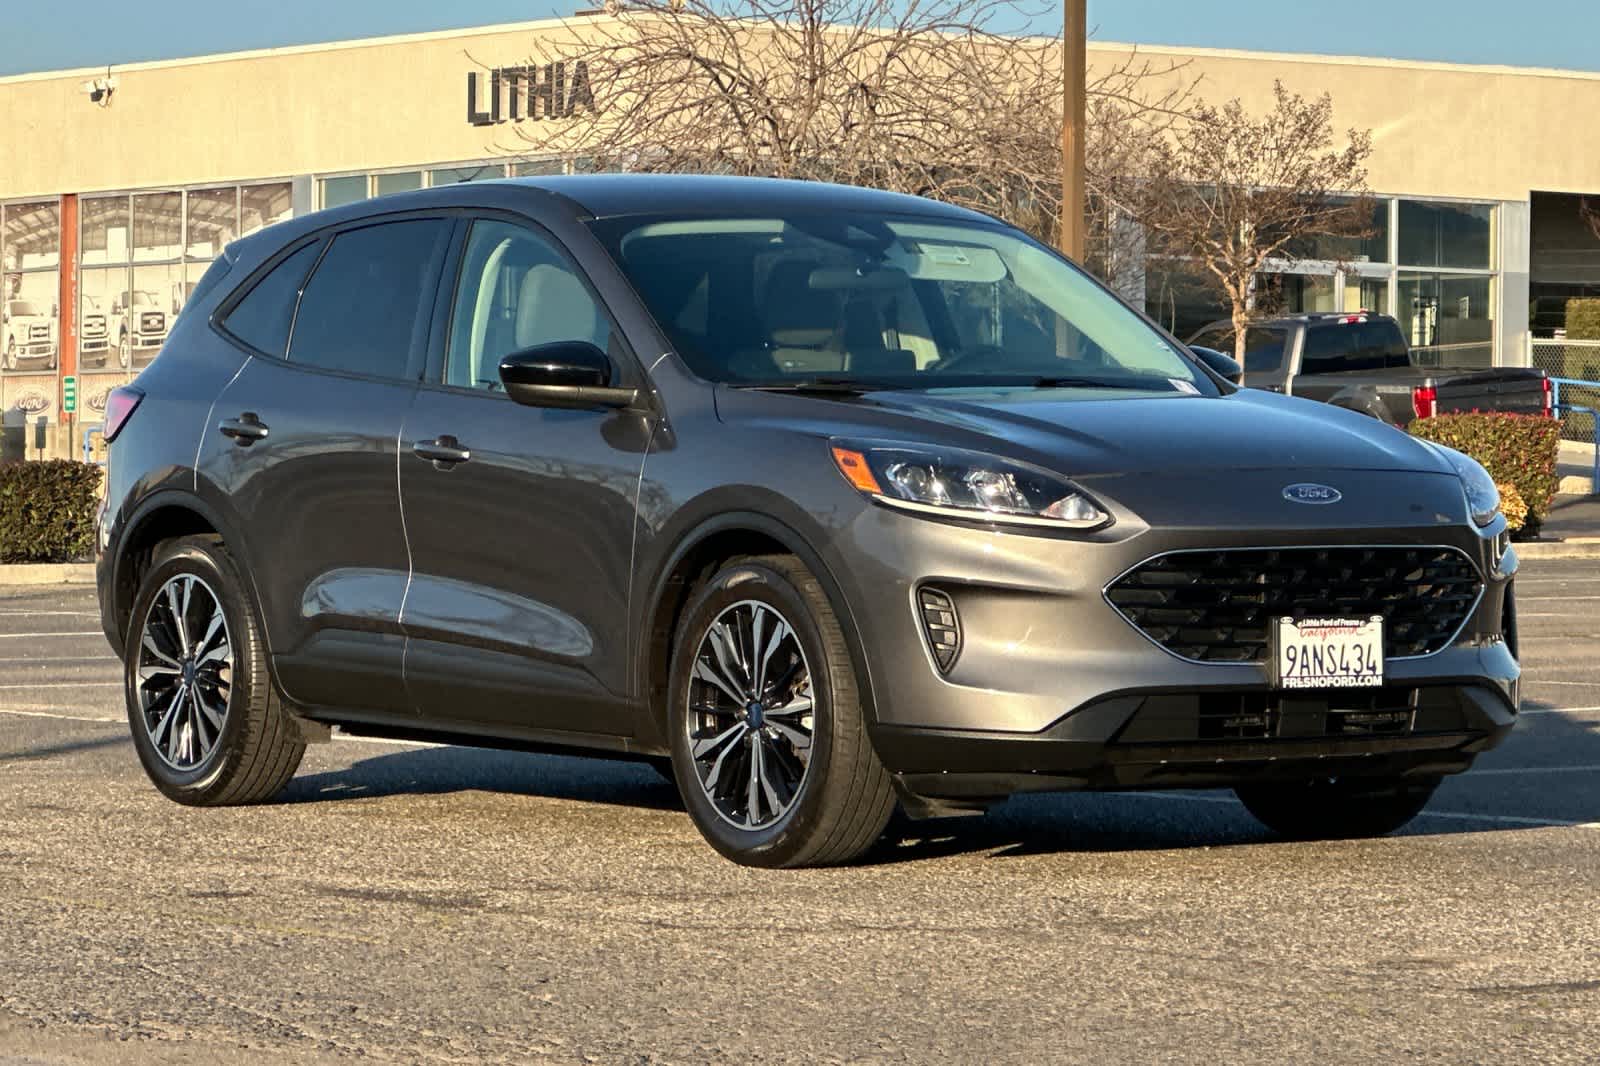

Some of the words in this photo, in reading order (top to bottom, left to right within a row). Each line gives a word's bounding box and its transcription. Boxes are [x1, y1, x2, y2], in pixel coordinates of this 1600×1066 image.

[468, 61, 596, 124] LITHIA
[1297, 487, 1330, 498] Ford
[1286, 643, 1378, 676] 9ANS434
[1282, 676, 1383, 688] FRESNOFORD.COM
